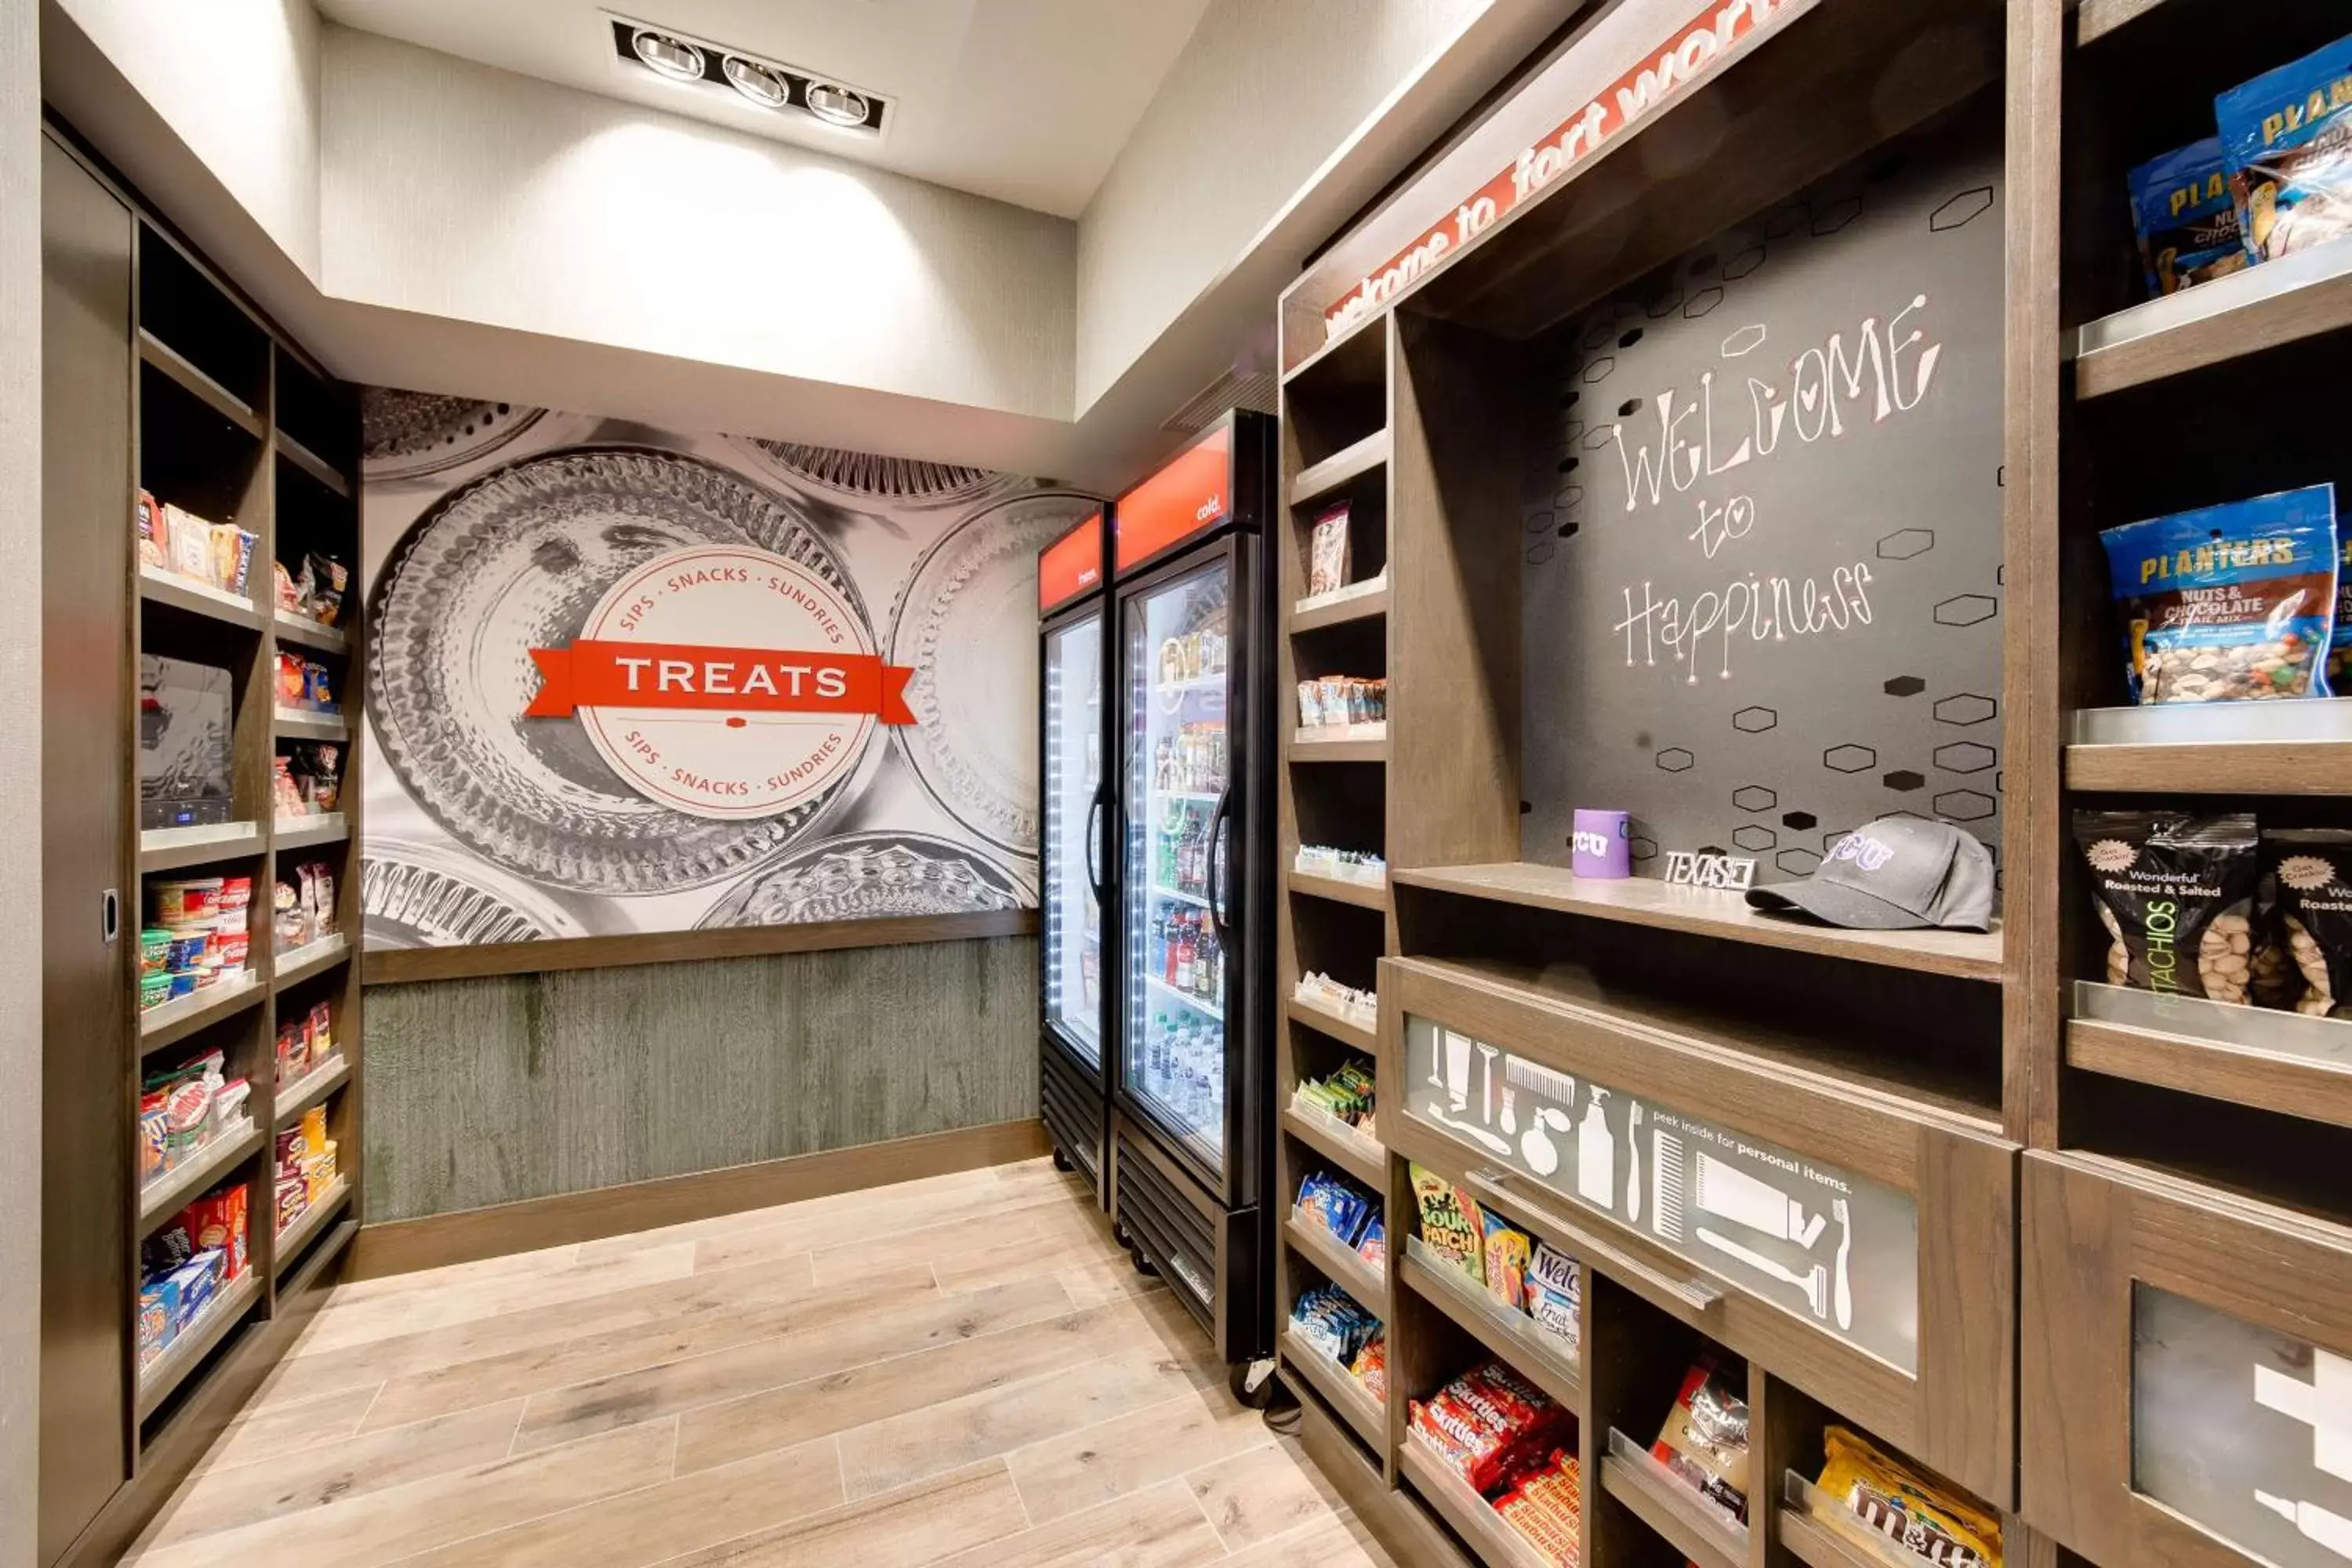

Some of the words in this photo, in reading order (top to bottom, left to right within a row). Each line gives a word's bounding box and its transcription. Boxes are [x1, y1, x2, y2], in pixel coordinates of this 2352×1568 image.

[1326, 231, 1450, 343] welcome
[1456, 197, 1497, 244] to
[1512, 102, 1607, 203] fort
[1613, 294, 1940, 512] WELCOME
[1689, 495, 1755, 558] to
[2140, 537, 2294, 584] PLANTERS
[620, 596, 655, 631] SIPS
[667, 568, 749, 593] SNACKS
[768, 577, 845, 645] SUNDRIES
[2165, 597, 2264, 619] CHOCOLATE
[2181, 587, 2226, 603] NUTS
[2228, 586, 2242, 600] &
[1614, 562, 1874, 683] Happiness
[615, 656, 848, 698] TREATS
[625, 730, 660, 765] SIPS
[671, 768, 749, 796] SNACKS
[768, 732, 842, 791] SUNDRIES
[1665, 851, 1730, 887] TEXAS
[2105, 880, 2161, 894] Roasted
[2164, 884, 2176, 895] &
[2179, 885, 2222, 898] Salted
[2129, 870, 2198, 884] Wonderful
[1653, 1111, 1679, 1128] peek
[1682, 1119, 1715, 1142] inside
[1717, 1133, 1735, 1149] for
[1737, 1142, 1799, 1174] personal
[1804, 1166, 1853, 1195] items.
[1423, 1223, 1475, 1254] PATCH
